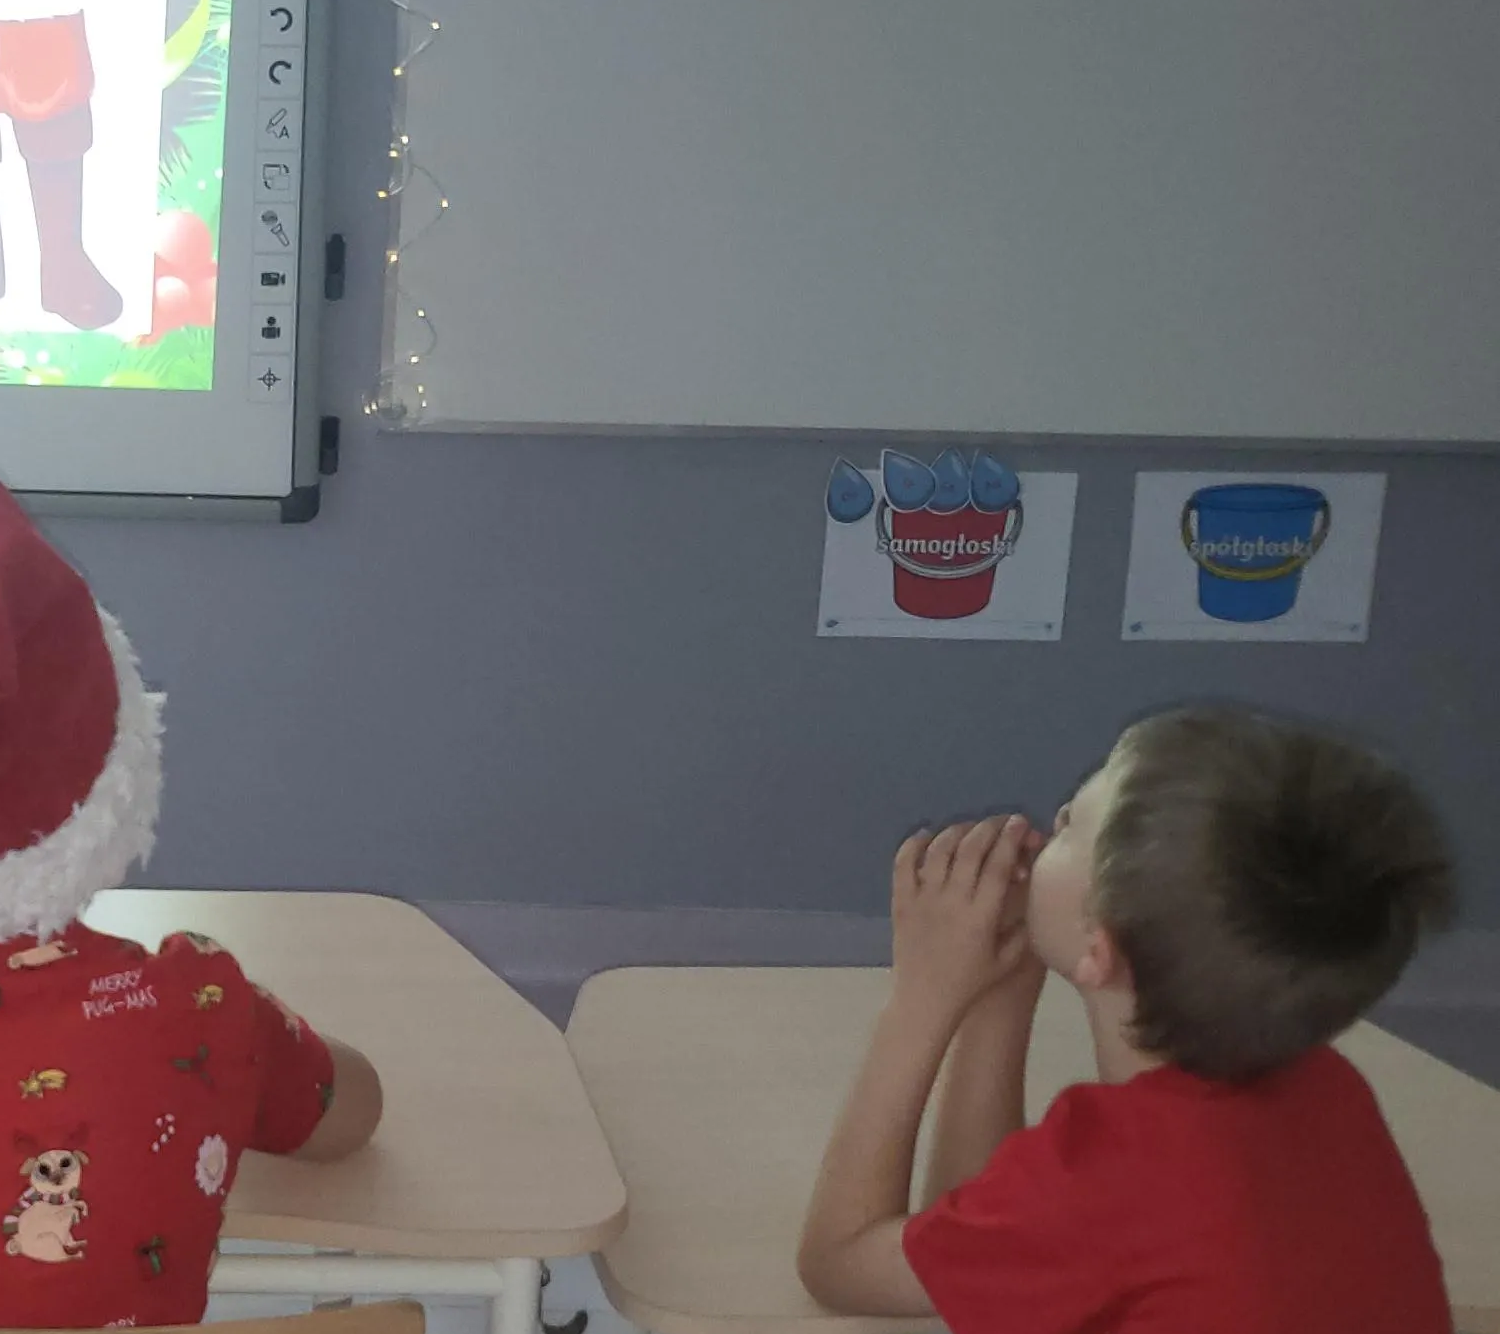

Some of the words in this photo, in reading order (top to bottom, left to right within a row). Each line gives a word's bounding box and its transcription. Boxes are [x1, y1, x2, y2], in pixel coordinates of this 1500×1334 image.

[876, 533, 1016, 561] samogłoski
[1189, 533, 1315, 564] spółgłoski
[89, 968, 142, 994] MERRY
[81, 984, 158, 1020] PUG-MAS
